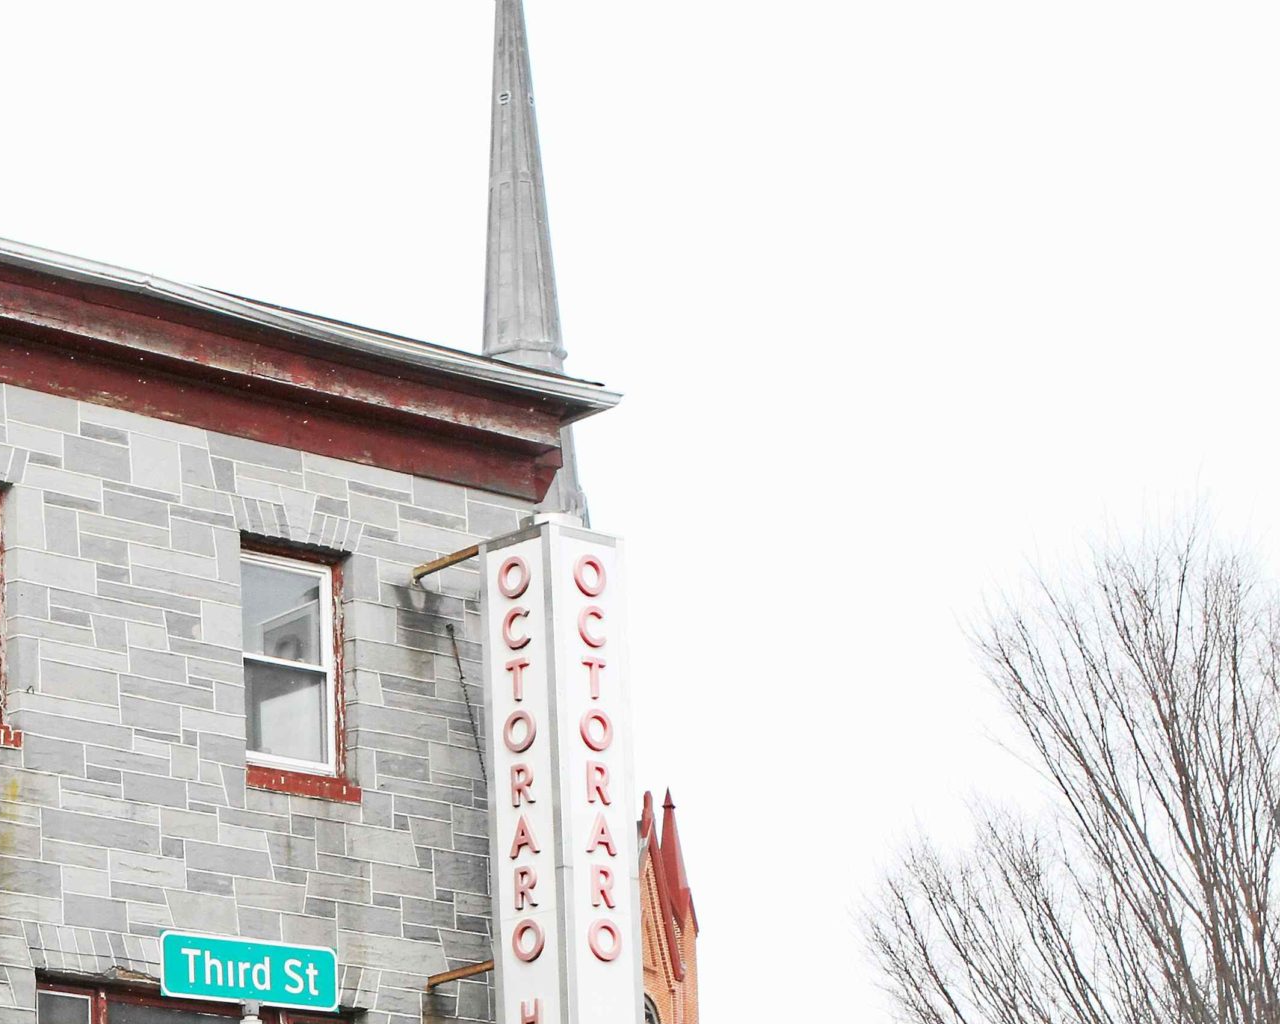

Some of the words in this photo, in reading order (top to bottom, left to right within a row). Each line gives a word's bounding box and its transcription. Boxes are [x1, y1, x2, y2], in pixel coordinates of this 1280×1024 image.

[498, 556, 545, 962] OCTORARO
[573, 554, 622, 962] OCTORARO
[181, 948, 270, 990] Third
[284, 958, 319, 996] St
